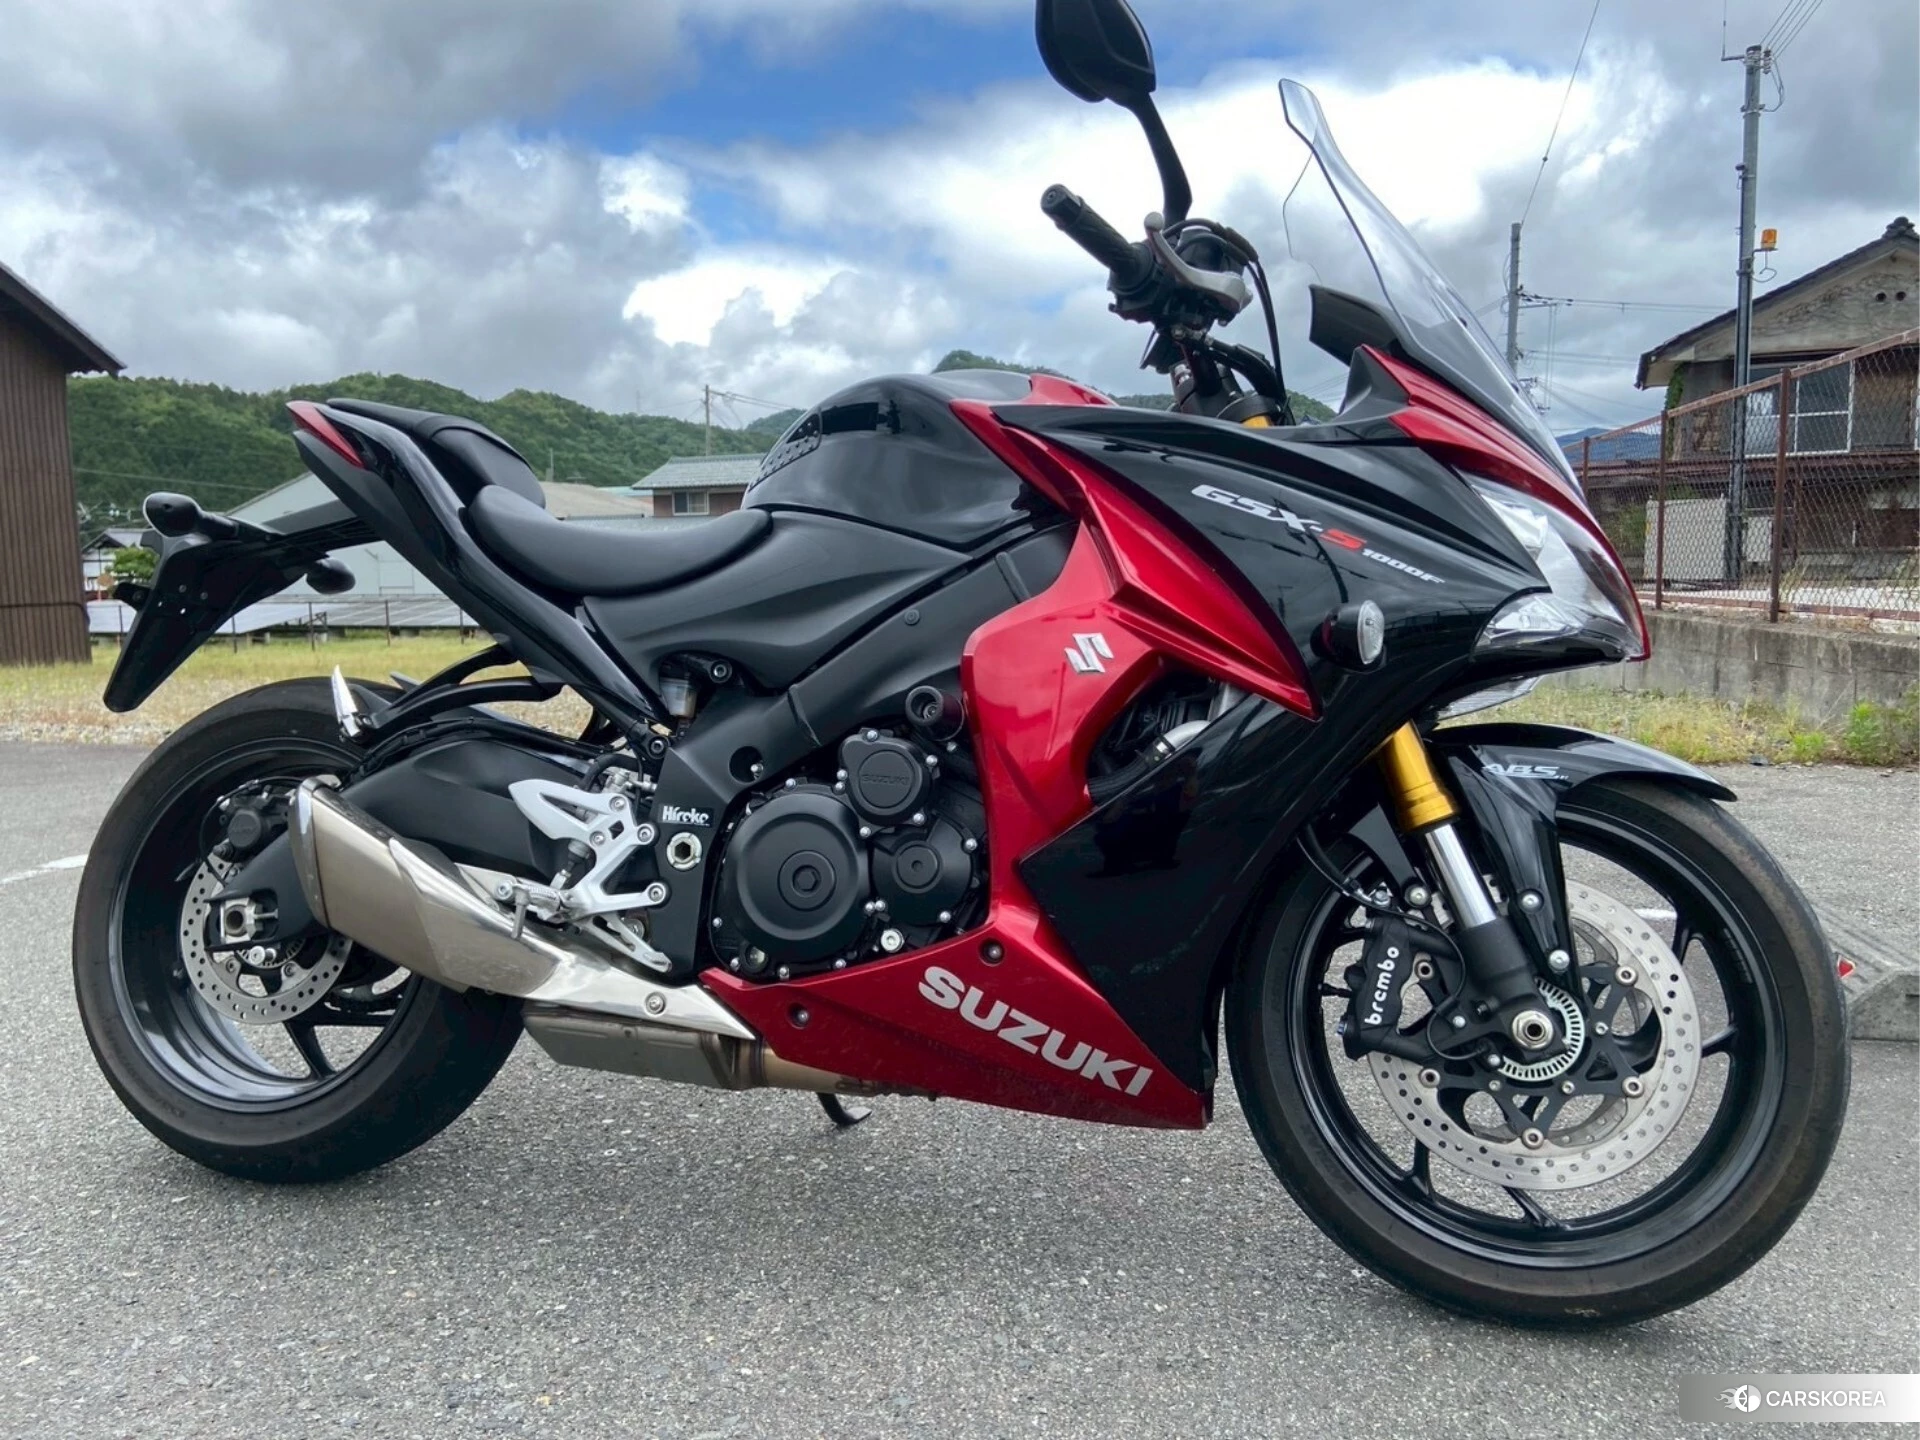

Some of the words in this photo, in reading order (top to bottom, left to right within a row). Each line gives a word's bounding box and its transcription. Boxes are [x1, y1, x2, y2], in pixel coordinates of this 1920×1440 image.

[1482, 763, 1560, 778] ABS
[1364, 946, 1400, 1026] brembo
[918, 966, 1154, 1097] SUZUKI
